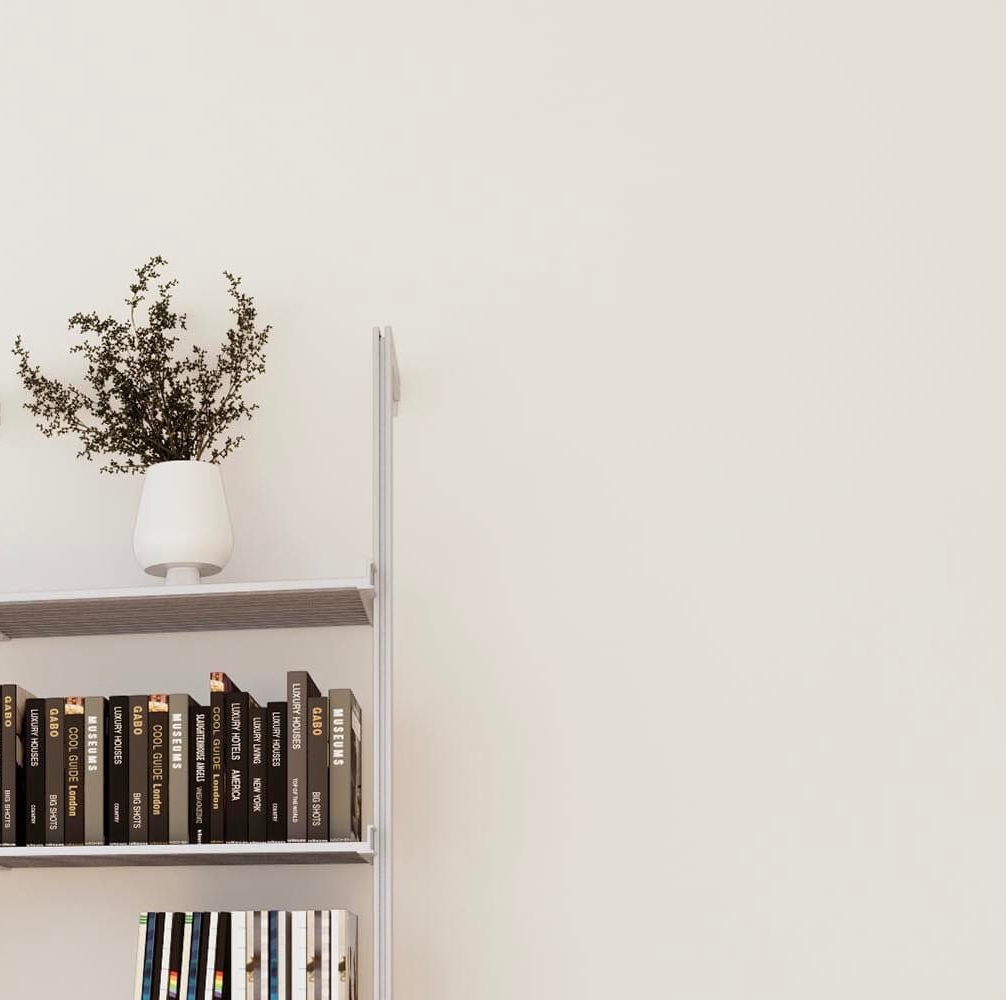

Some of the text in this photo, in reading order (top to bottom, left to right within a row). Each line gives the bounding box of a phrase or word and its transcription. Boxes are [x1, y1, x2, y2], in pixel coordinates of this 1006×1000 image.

[4, 696, 12, 728] GABO
[30, 709, 39, 767] LUXURY HOUSES
[49, 708, 59, 738] GABO
[113, 706, 122, 765] LUXURY HOUSES
[133, 705, 143, 736] GABO
[272, 712, 281, 767] LUXURY HOUSES
[292, 683, 301, 750] LUXURY HOUSES
[312, 707, 322, 736] GABO
[332, 708, 344, 766] MUSEUMS
[87, 715, 98, 772] MUSEUMS
[172, 713, 182, 769] MUSEUMS
[212, 706, 221, 810] COOL GUIDE London
[231, 703, 240, 802] LUXURY HOTELS AMERICA
[252, 717, 261, 812] LUXURY LIVING NEW YORK
[68, 726, 78, 817] COOL GUIDE London
[152, 724, 163, 816] COOL GUIDE London
[195, 762, 205, 782] ANGELS
[49, 794, 57, 830] BIG SHOTS
[133, 792, 141, 829] BIG SHOTS
[312, 791, 321, 826] BIG SHOTS
